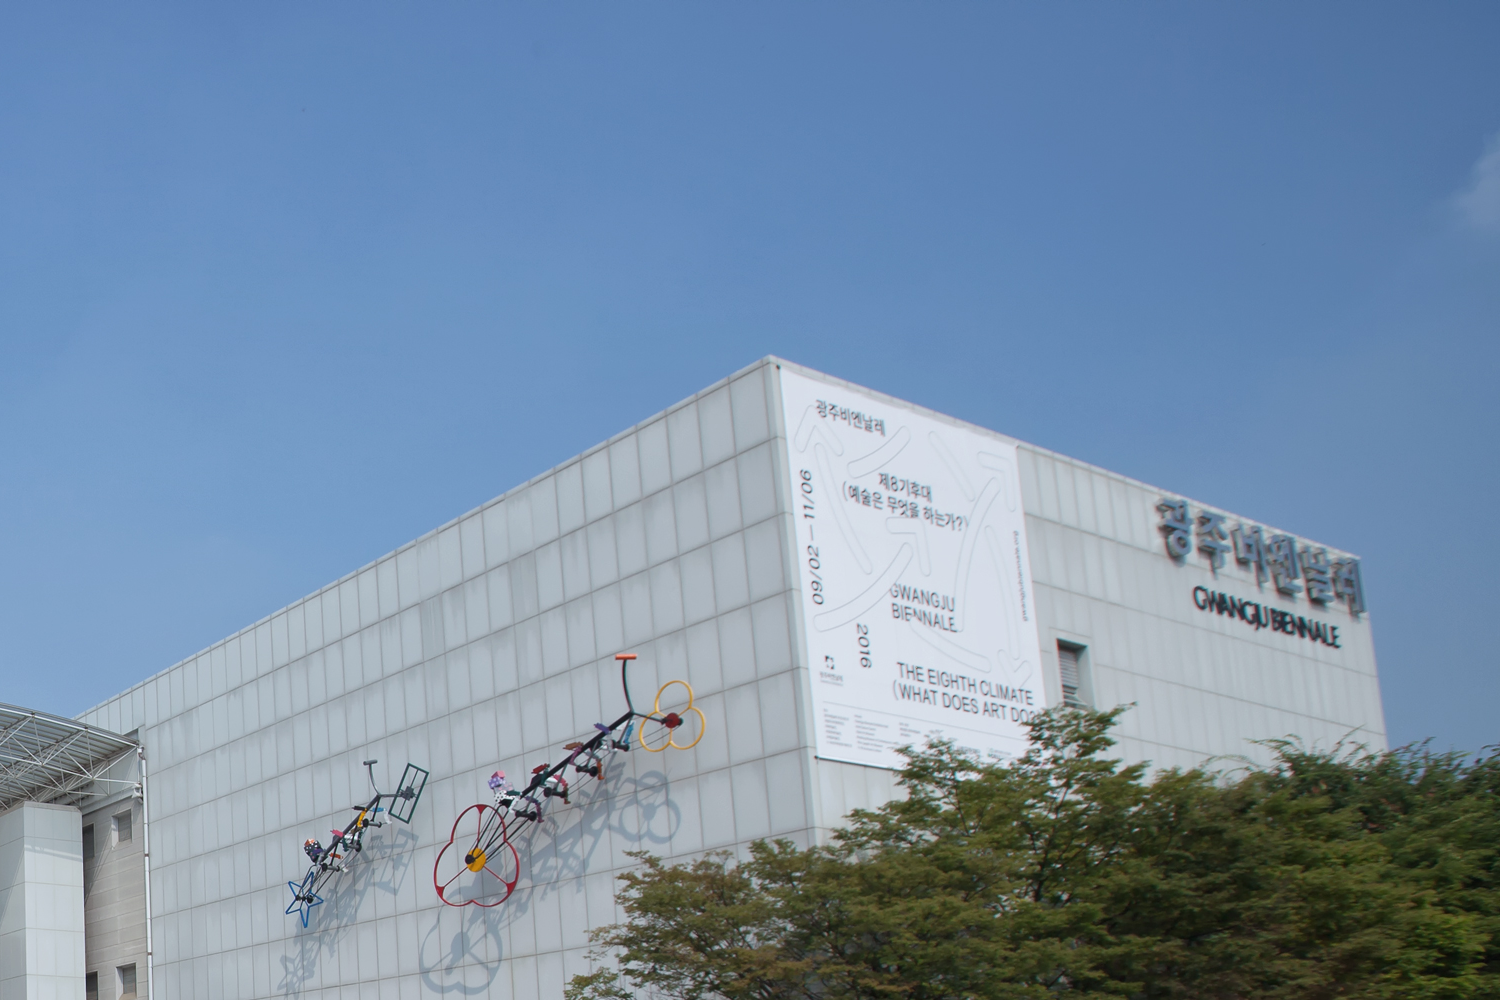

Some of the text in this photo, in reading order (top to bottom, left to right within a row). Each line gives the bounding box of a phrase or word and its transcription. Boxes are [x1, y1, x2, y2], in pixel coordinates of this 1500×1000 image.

[816, 399, 886, 437] 광주비엔날레
[842, 480, 969, 531] (예술은 무엇을 하는가?)
[878, 472, 933, 503] 제8기후대
[1156, 497, 1368, 620] 광주비엔날레
[890, 583, 956, 612] GWANGJU
[891, 602, 958, 633] BIENNALE
[1192, 585, 1342, 650] GWANGJU BIENNALE
[856, 622, 873, 669] 2016
[893, 679, 938, 706] (WHAT
[941, 692, 979, 715] DOES
[982, 701, 1007, 720] ART
[896, 661, 1034, 706] THE EIGHTH CLIMATE
